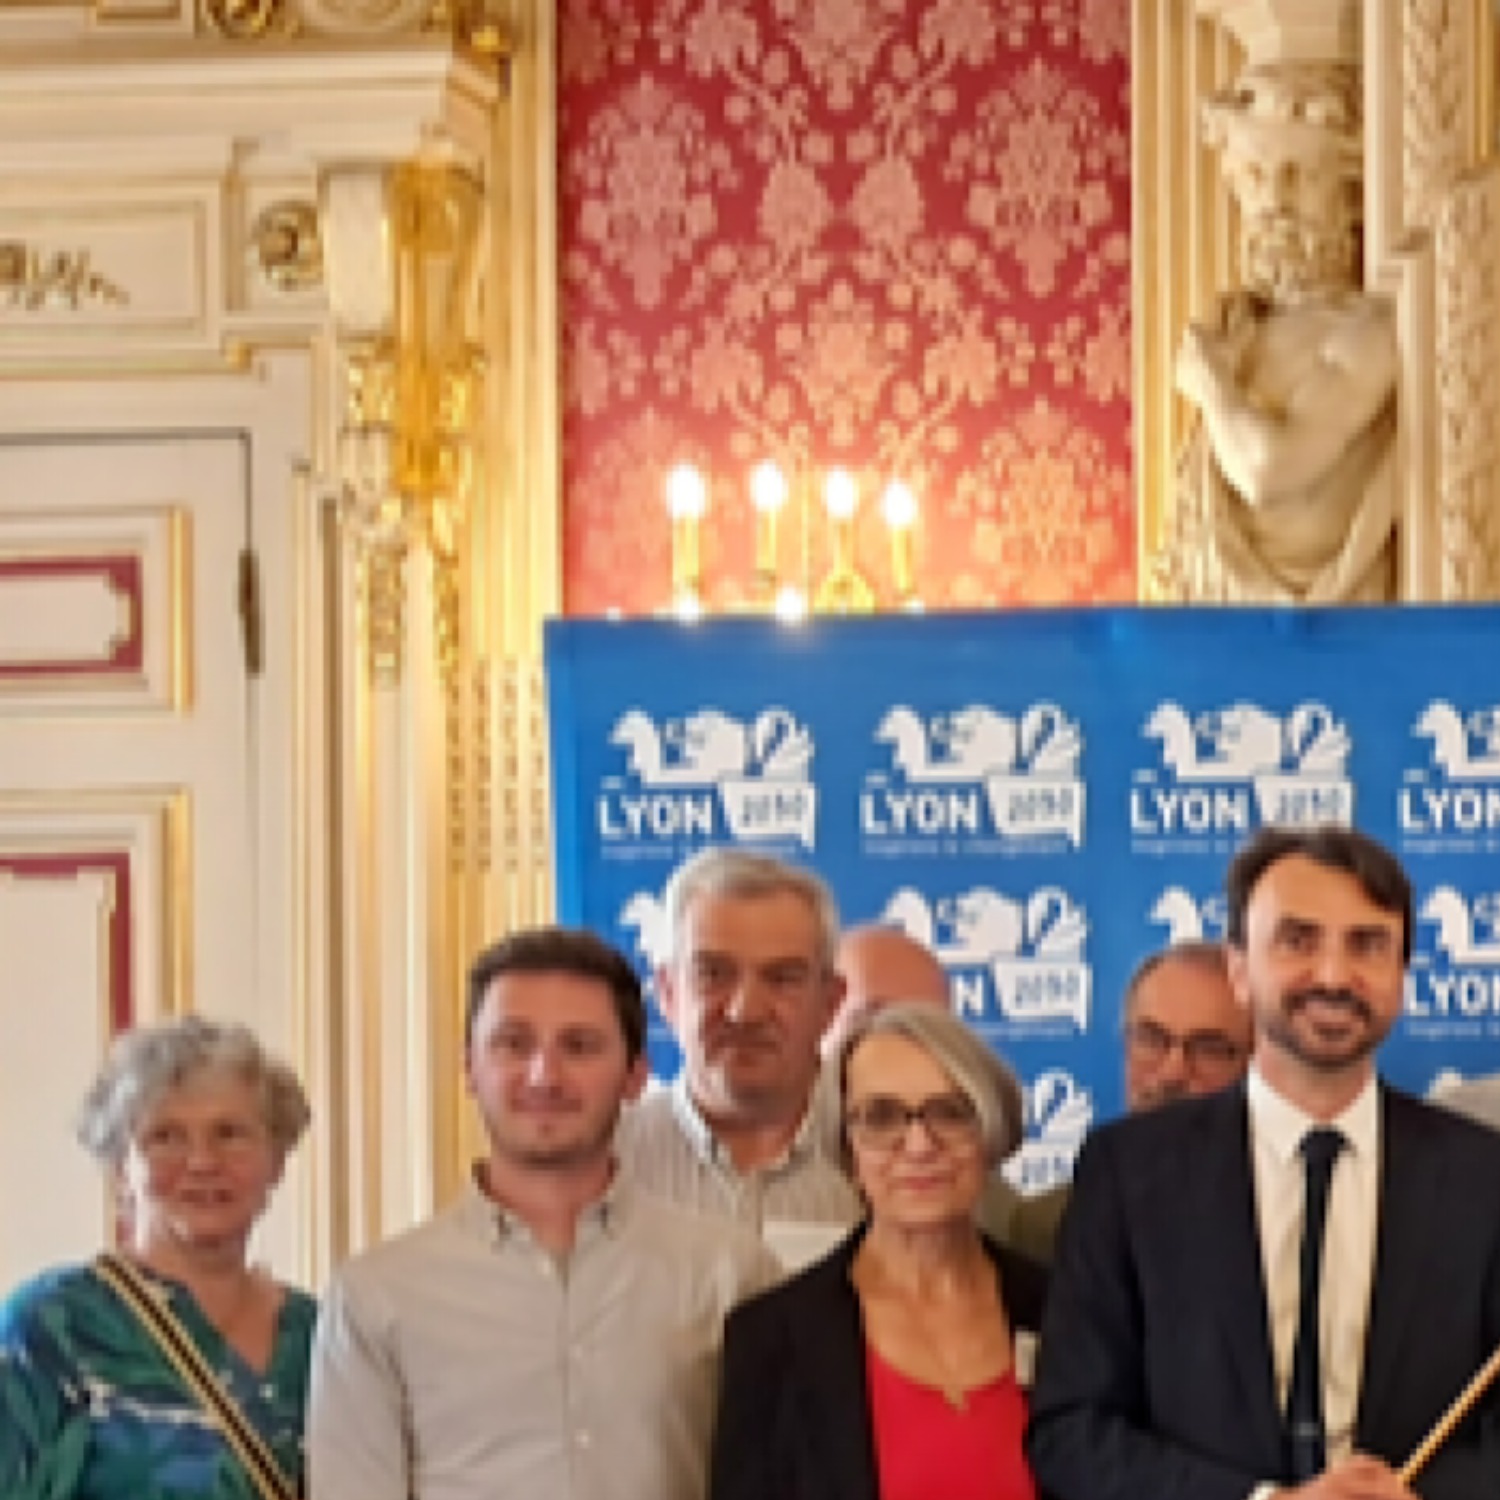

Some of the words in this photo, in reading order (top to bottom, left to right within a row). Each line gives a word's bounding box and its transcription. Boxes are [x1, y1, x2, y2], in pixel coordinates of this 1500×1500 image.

[600, 795, 713, 836] LYON
[862, 790, 977, 834] LYON
[1131, 788, 1249, 832] LYON
